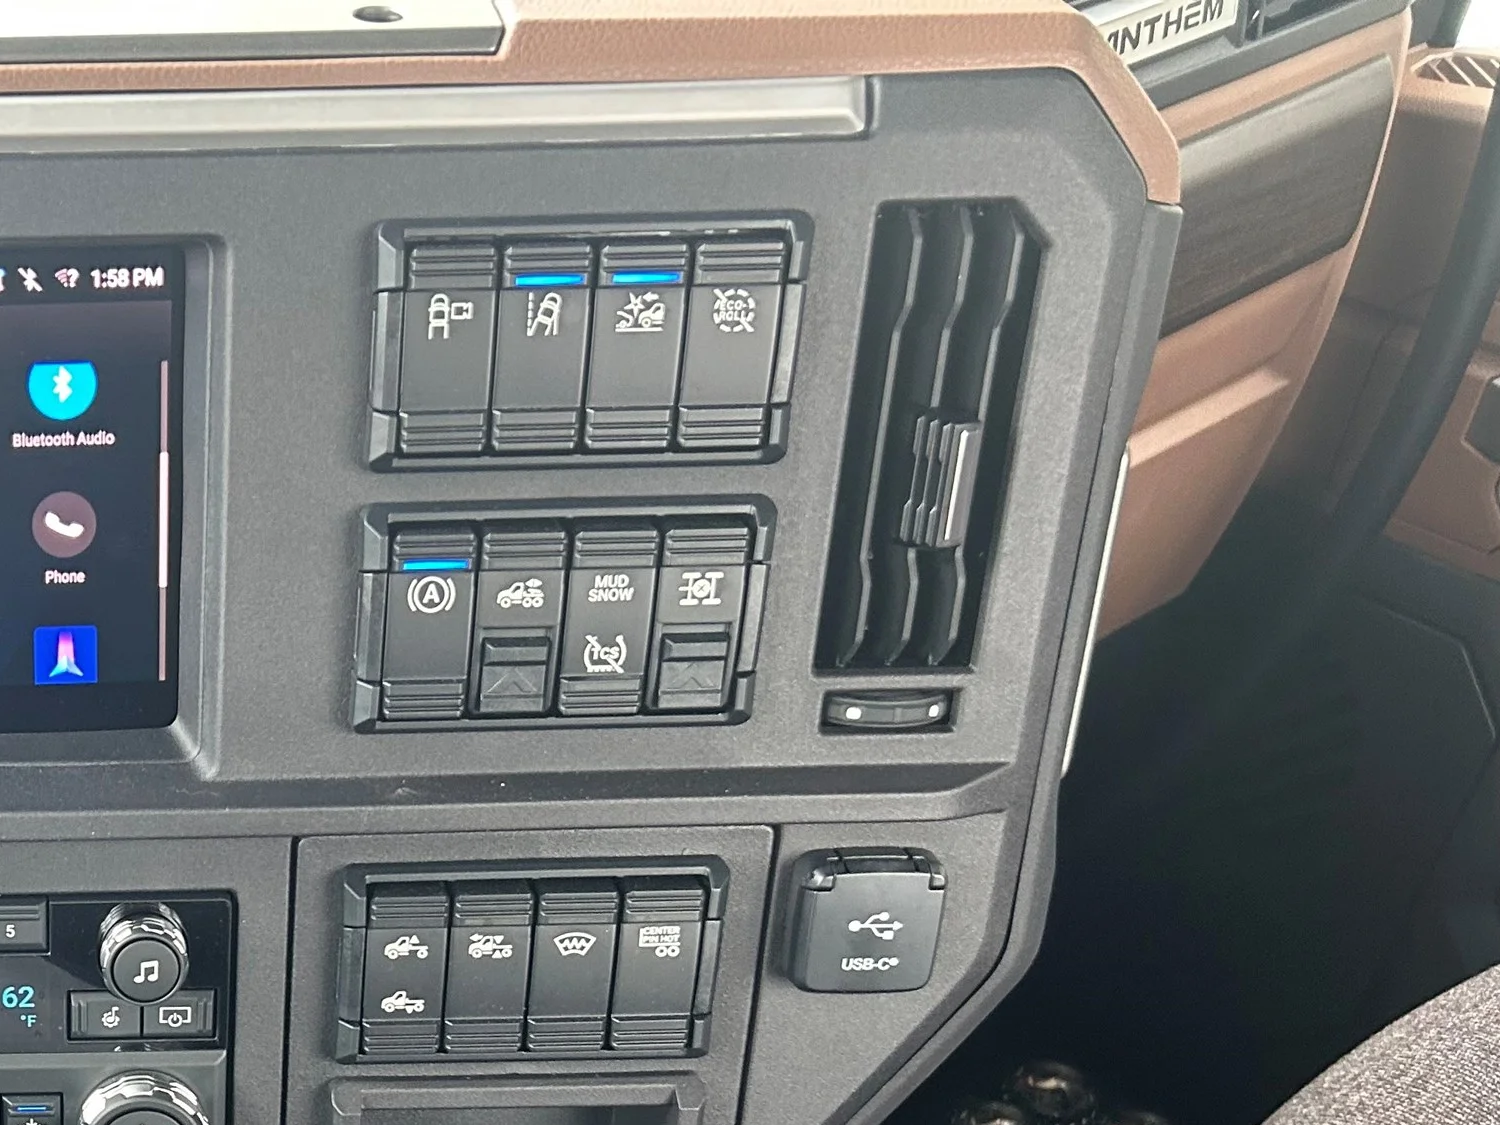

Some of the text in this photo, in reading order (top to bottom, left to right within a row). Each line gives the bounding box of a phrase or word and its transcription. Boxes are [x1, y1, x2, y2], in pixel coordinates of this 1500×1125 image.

[90, 266, 165, 289] 1:58 PM
[12, 430, 116, 448] Bluetooth Audio
[44, 569, 86, 585] Phone
[594, 573, 630, 590] MUD
[587, 586, 635, 603] SNOW
[591, 647, 619, 660] TCS
[5, 924, 16, 938] 5
[2, 985, 36, 1008] 62
